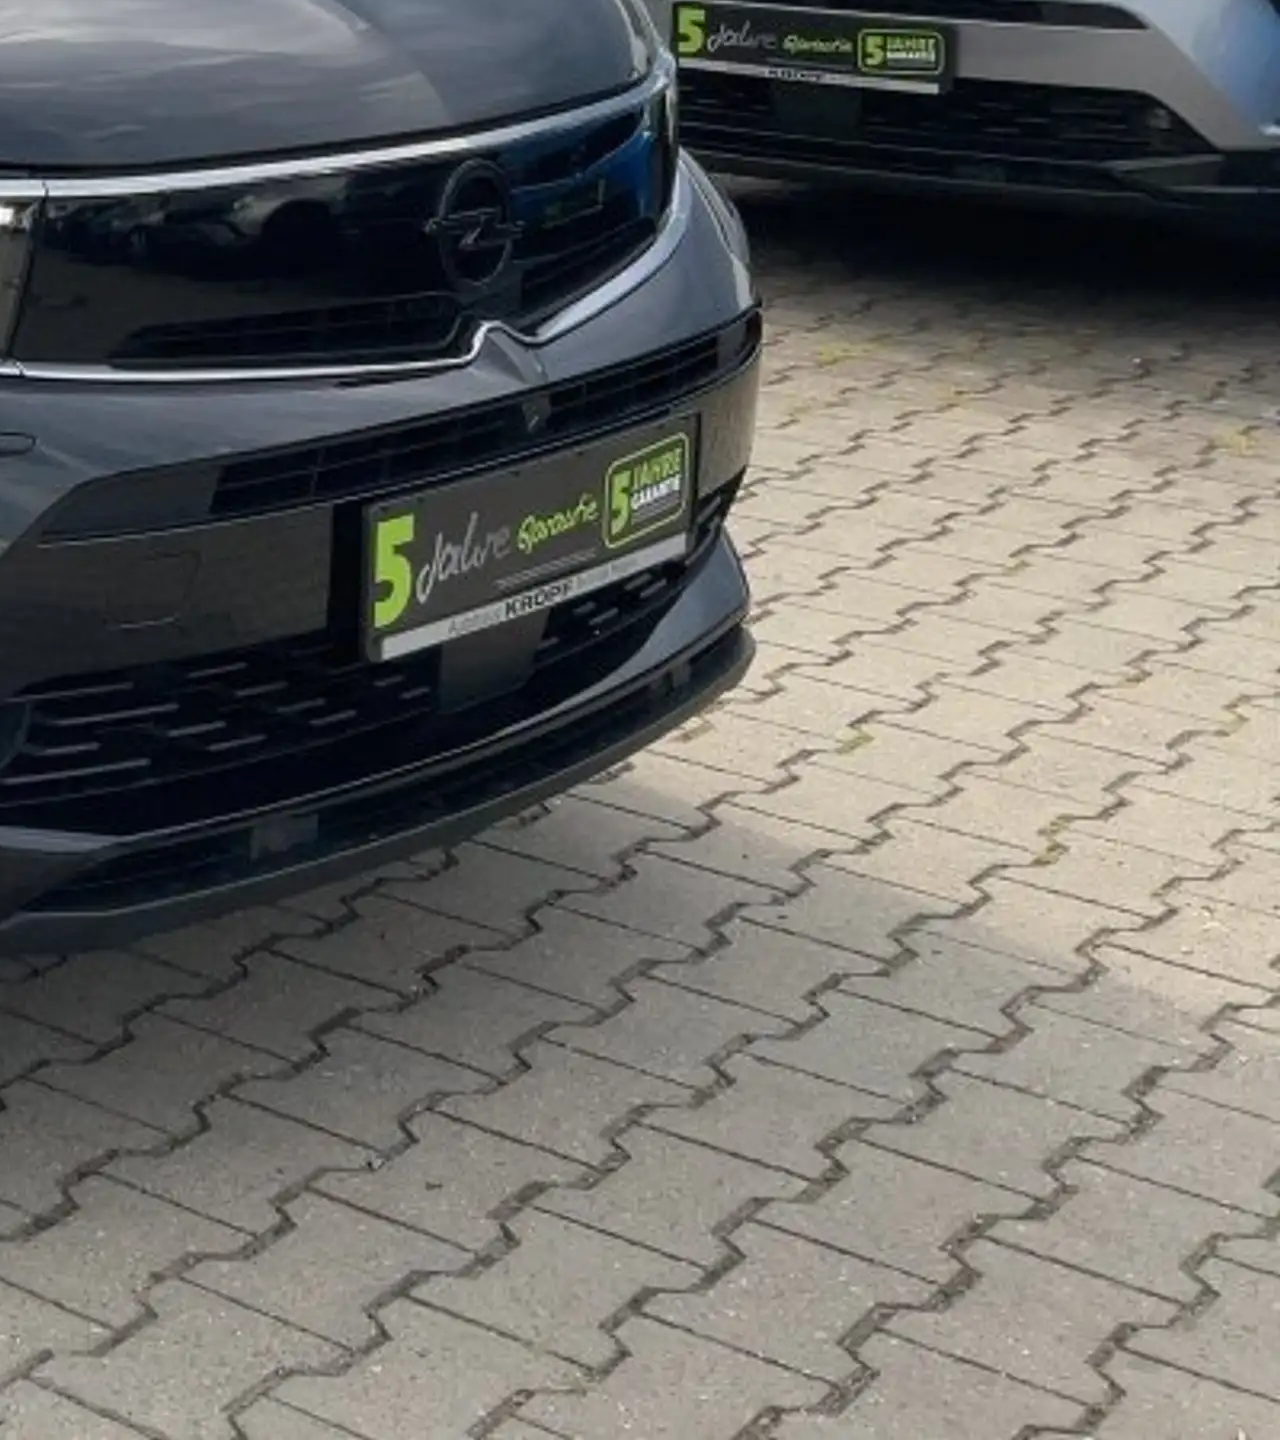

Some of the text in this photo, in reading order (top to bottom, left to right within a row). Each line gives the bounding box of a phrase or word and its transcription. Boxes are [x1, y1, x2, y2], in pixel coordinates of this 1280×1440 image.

[677, 6, 706, 53] 5
[864, 36, 884, 65] 5
[611, 471, 631, 536] 5
[374, 514, 414, 629] 5
